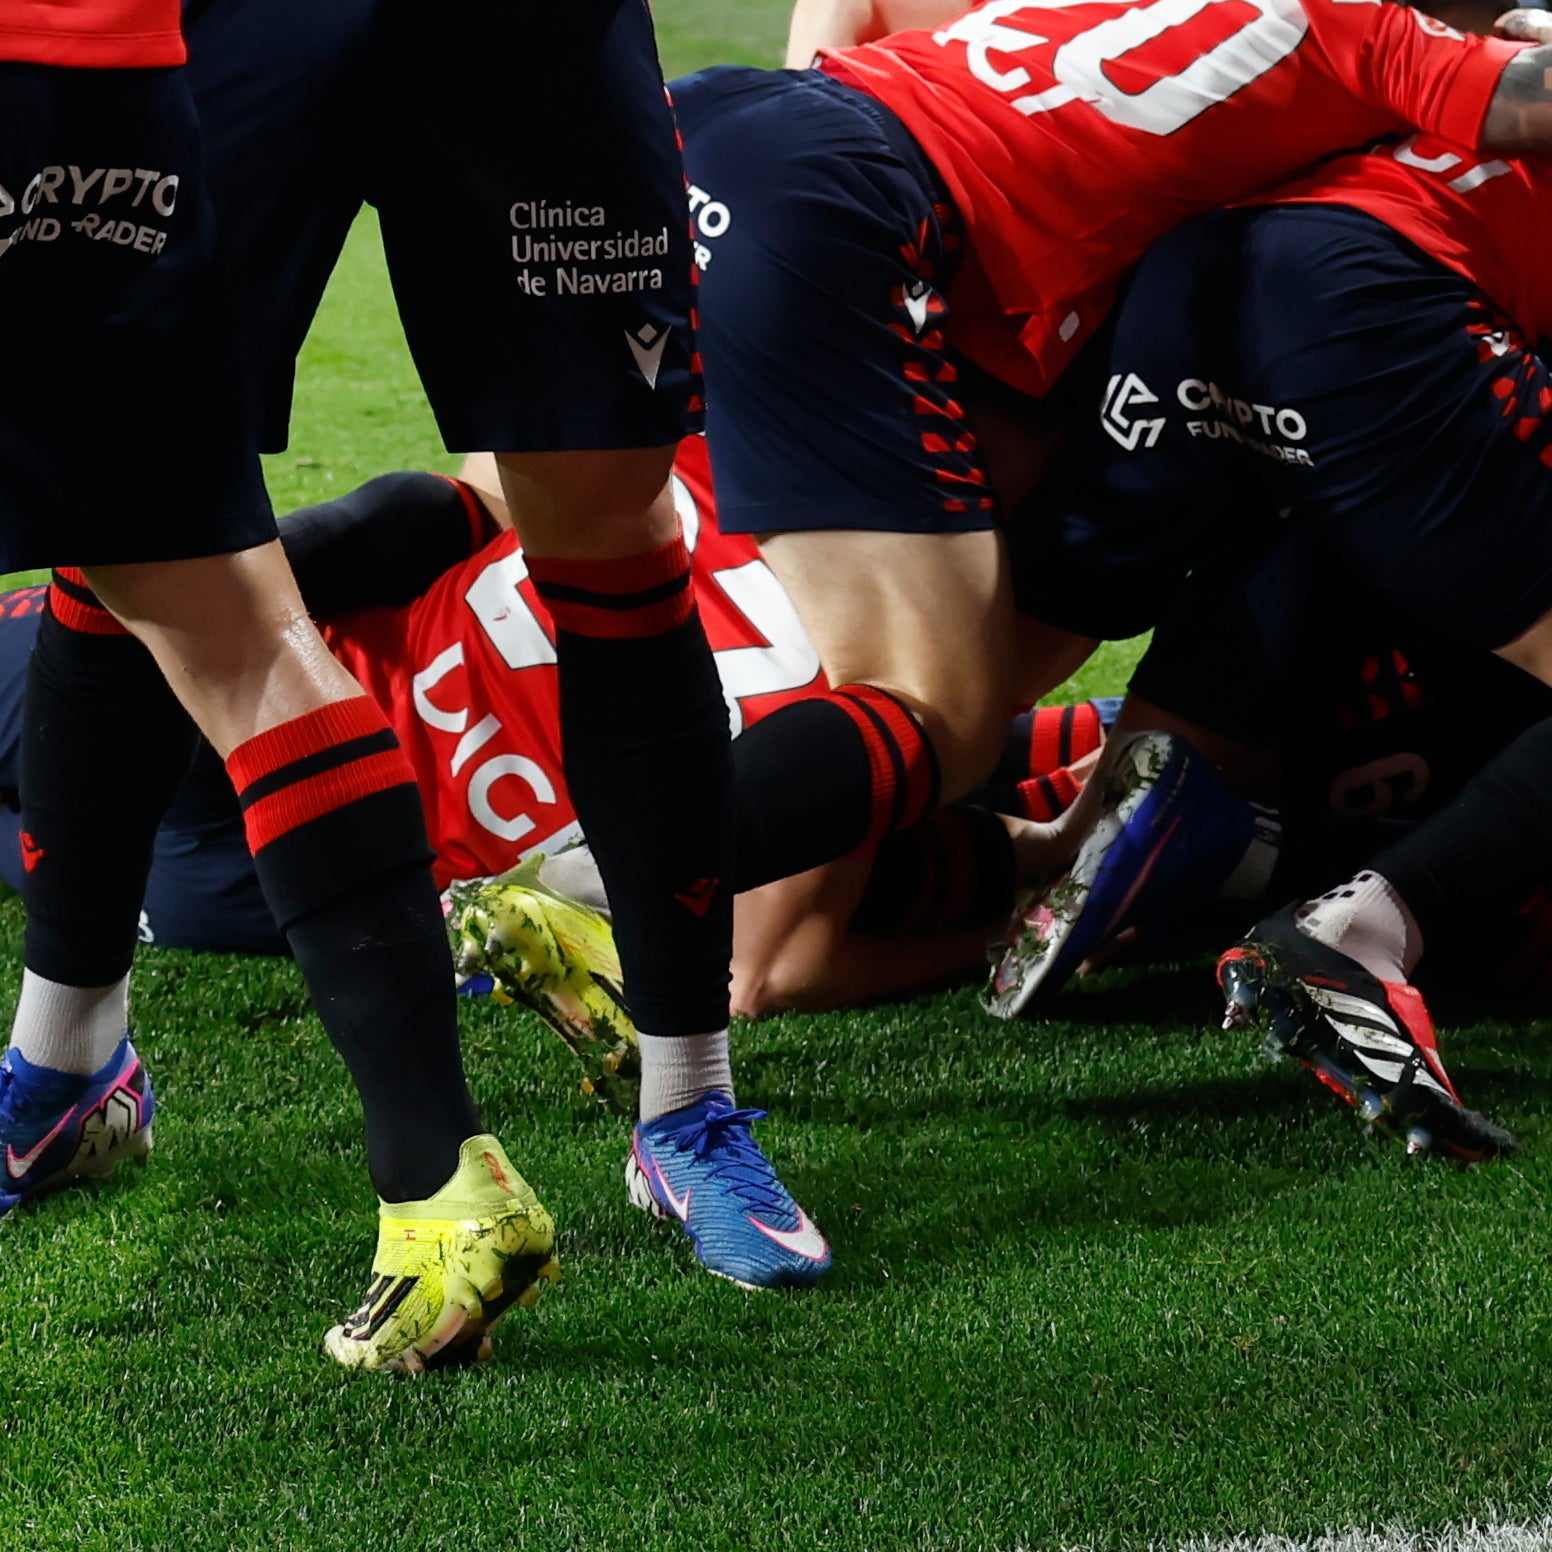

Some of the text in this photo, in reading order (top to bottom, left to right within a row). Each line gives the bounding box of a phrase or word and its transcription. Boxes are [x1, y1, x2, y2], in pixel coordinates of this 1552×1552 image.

[509, 200, 606, 230] Clínica
[511, 226, 670, 263] Universidad
[516, 266, 664, 297] de Navarra
